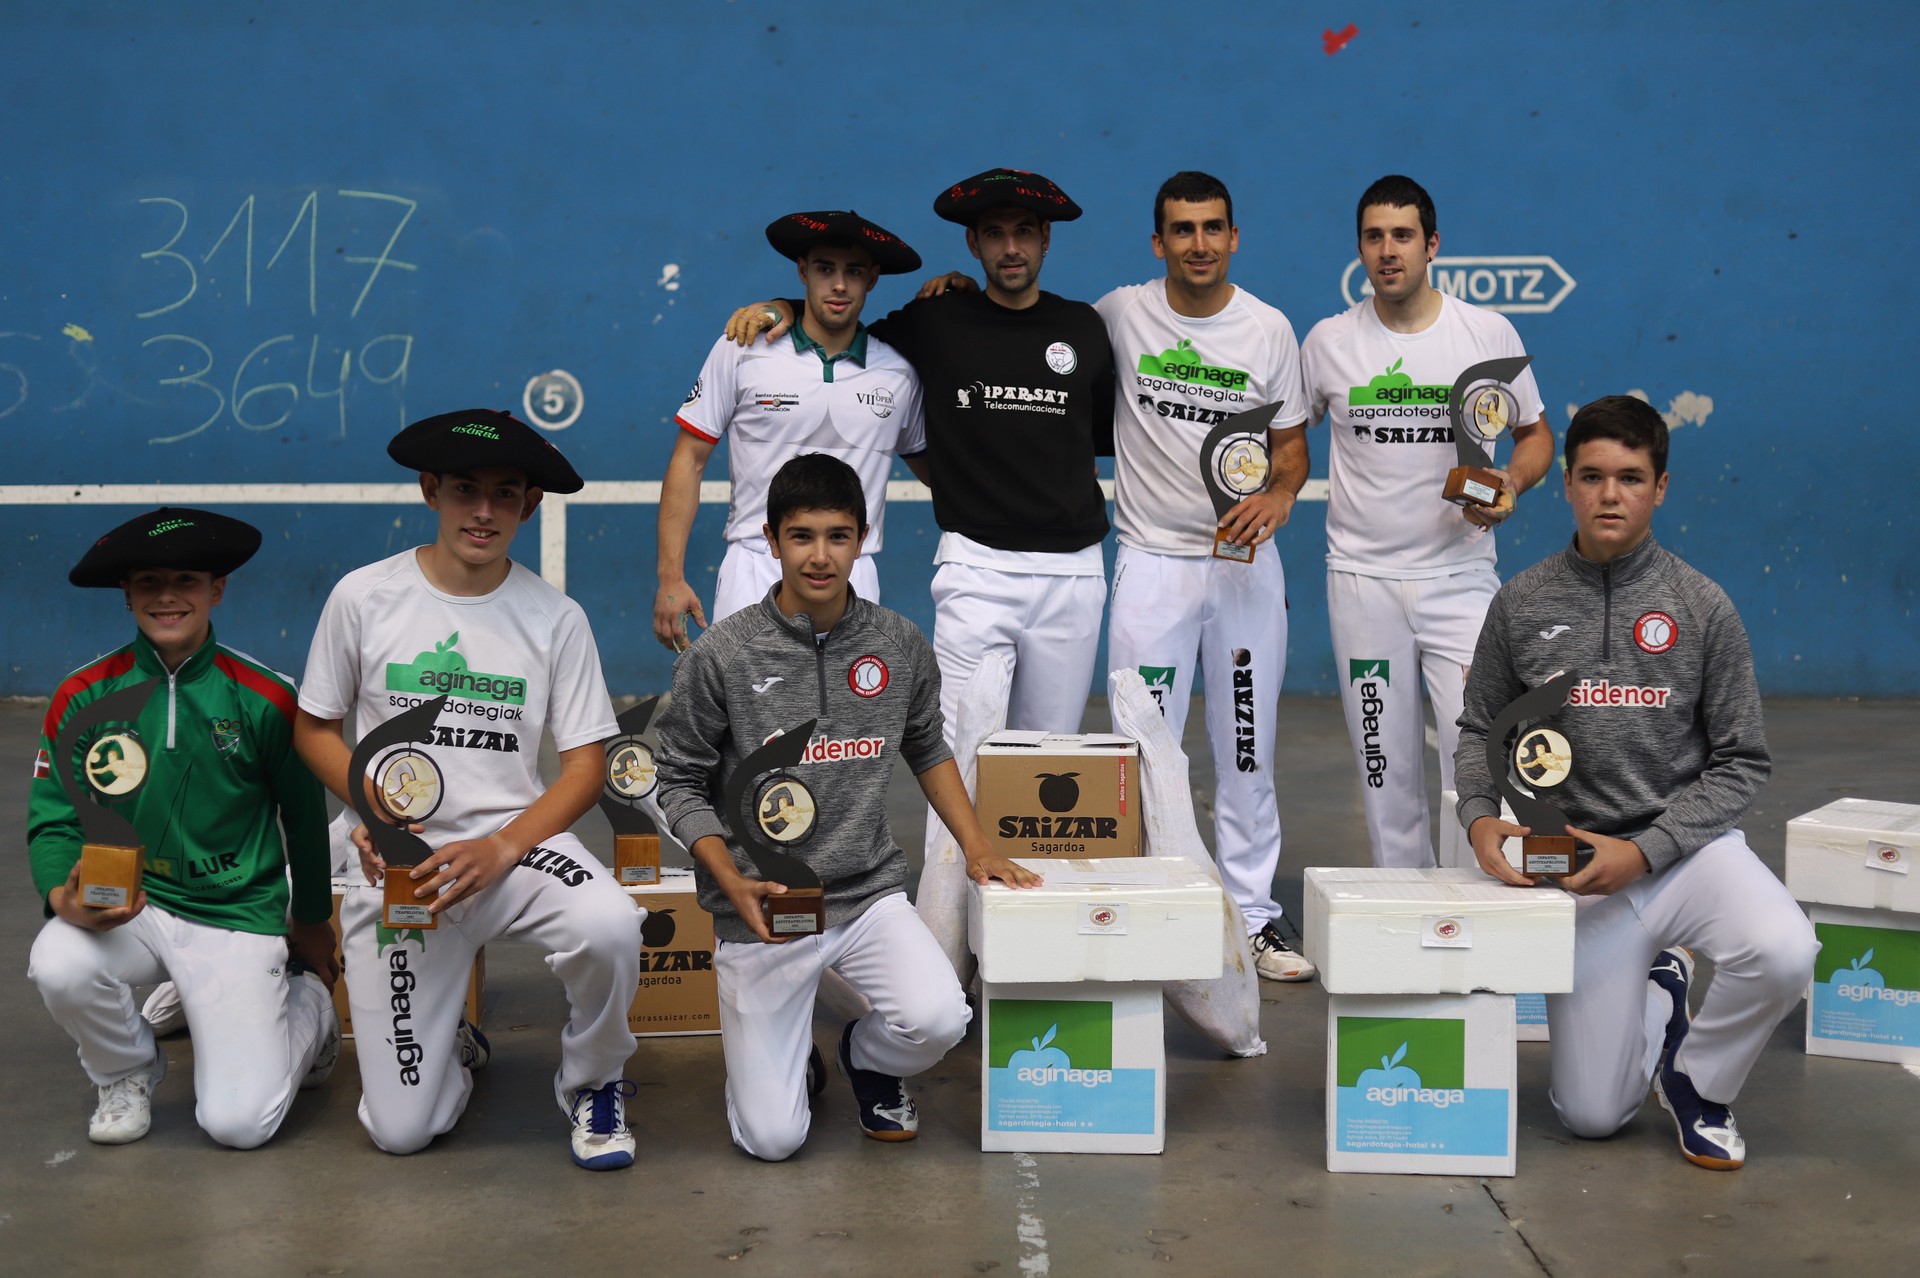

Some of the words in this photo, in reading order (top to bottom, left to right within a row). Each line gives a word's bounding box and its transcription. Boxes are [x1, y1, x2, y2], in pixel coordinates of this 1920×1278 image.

[137, 190, 417, 318] 3117
[1437, 269, 1544, 301] MOTZ
[142, 334, 414, 444] 3649
[543, 384, 564, 415] 5
[856, 393, 875, 405] VII
[1137, 376, 1245, 402] sagardotegiak
[1375, 383, 1451, 403] aginag
[984, 401, 1066, 415] Telecomunicaciones
[1157, 400, 1241, 425] SAiZA
[1349, 405, 1451, 419] sagardotegi
[452, 426, 500, 440] USURBIL
[1570, 681, 1668, 706] sidenor
[389, 694, 524, 721] sagdotegiak
[803, 737, 883, 762] idenor
[1031, 841, 1085, 854] Sagardoa
[188, 851, 240, 878] LUR
[193, 875, 243, 892] CAVACIONES
[640, 950, 712, 973] iZAR
[638, 976, 682, 988] agardoa
